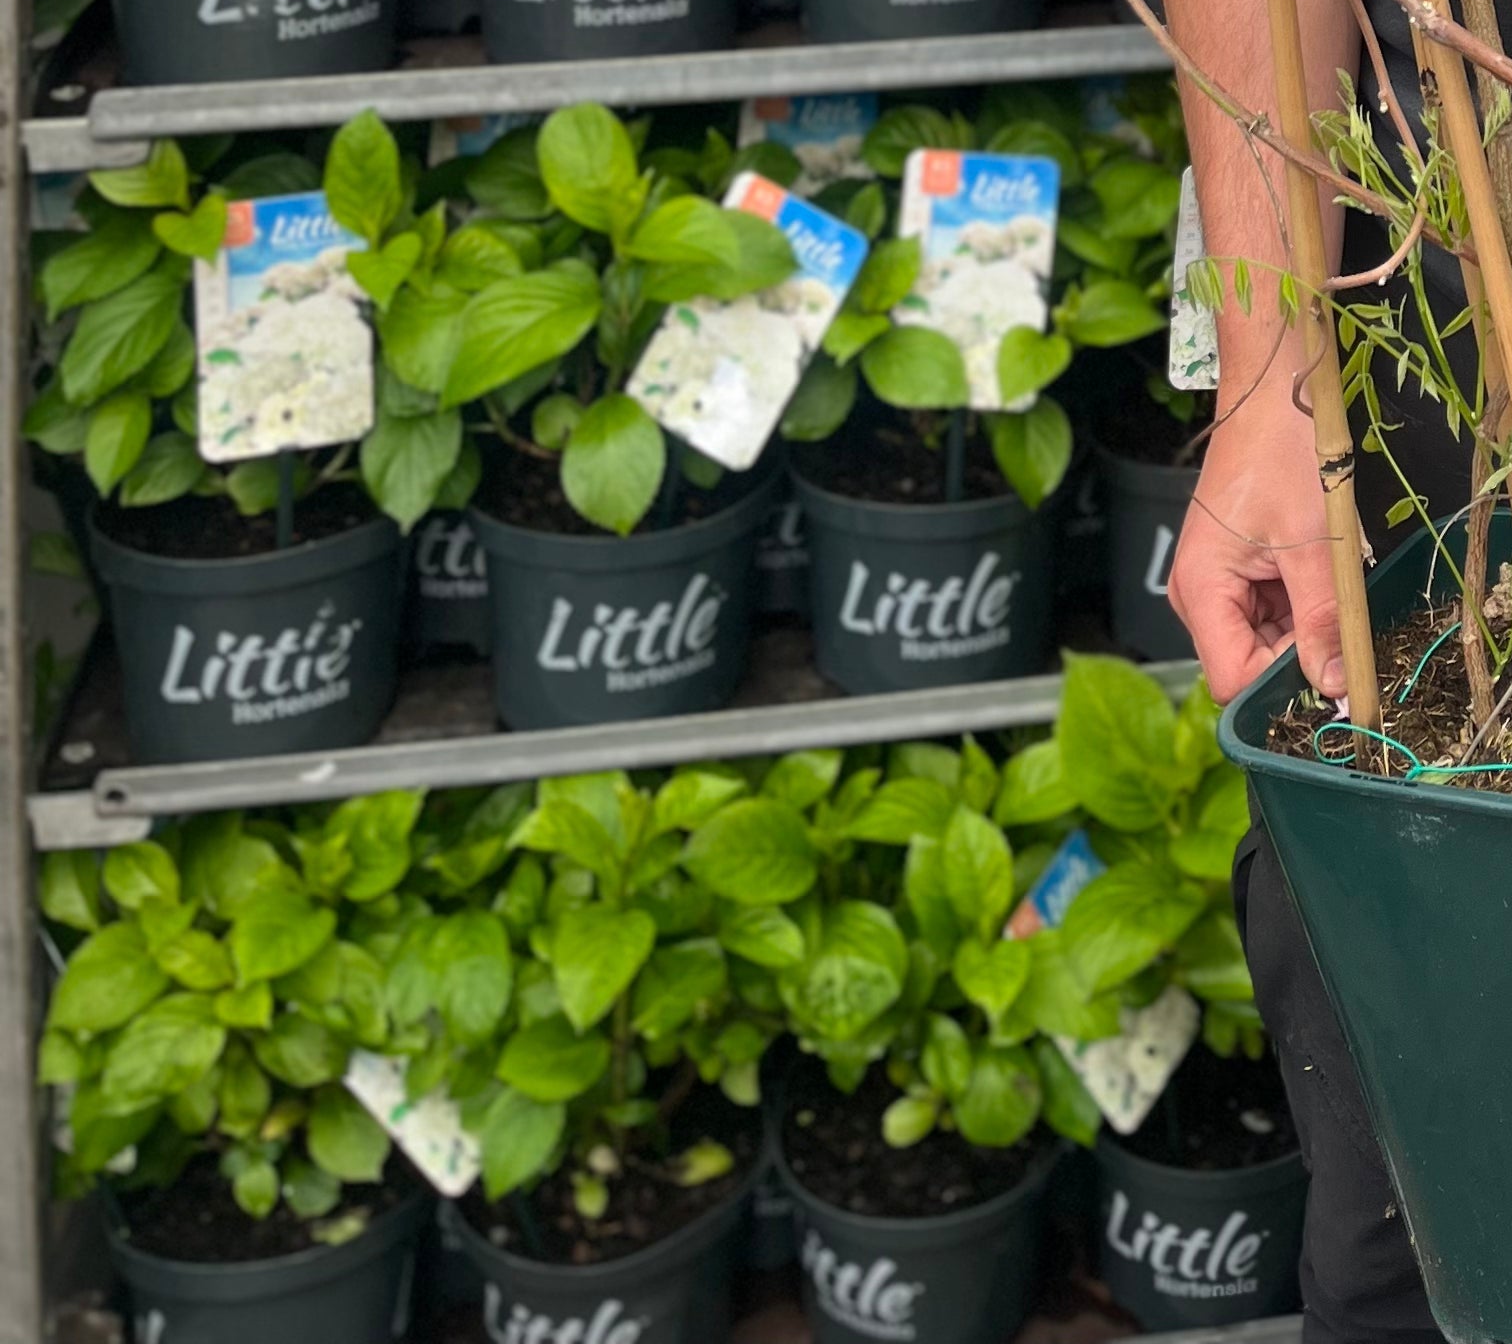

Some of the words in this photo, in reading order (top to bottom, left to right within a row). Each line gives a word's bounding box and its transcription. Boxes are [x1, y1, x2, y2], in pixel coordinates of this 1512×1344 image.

[538, 573, 721, 672] Little
[839, 551, 1014, 638] Little
[1106, 1189, 1262, 1281] Little
